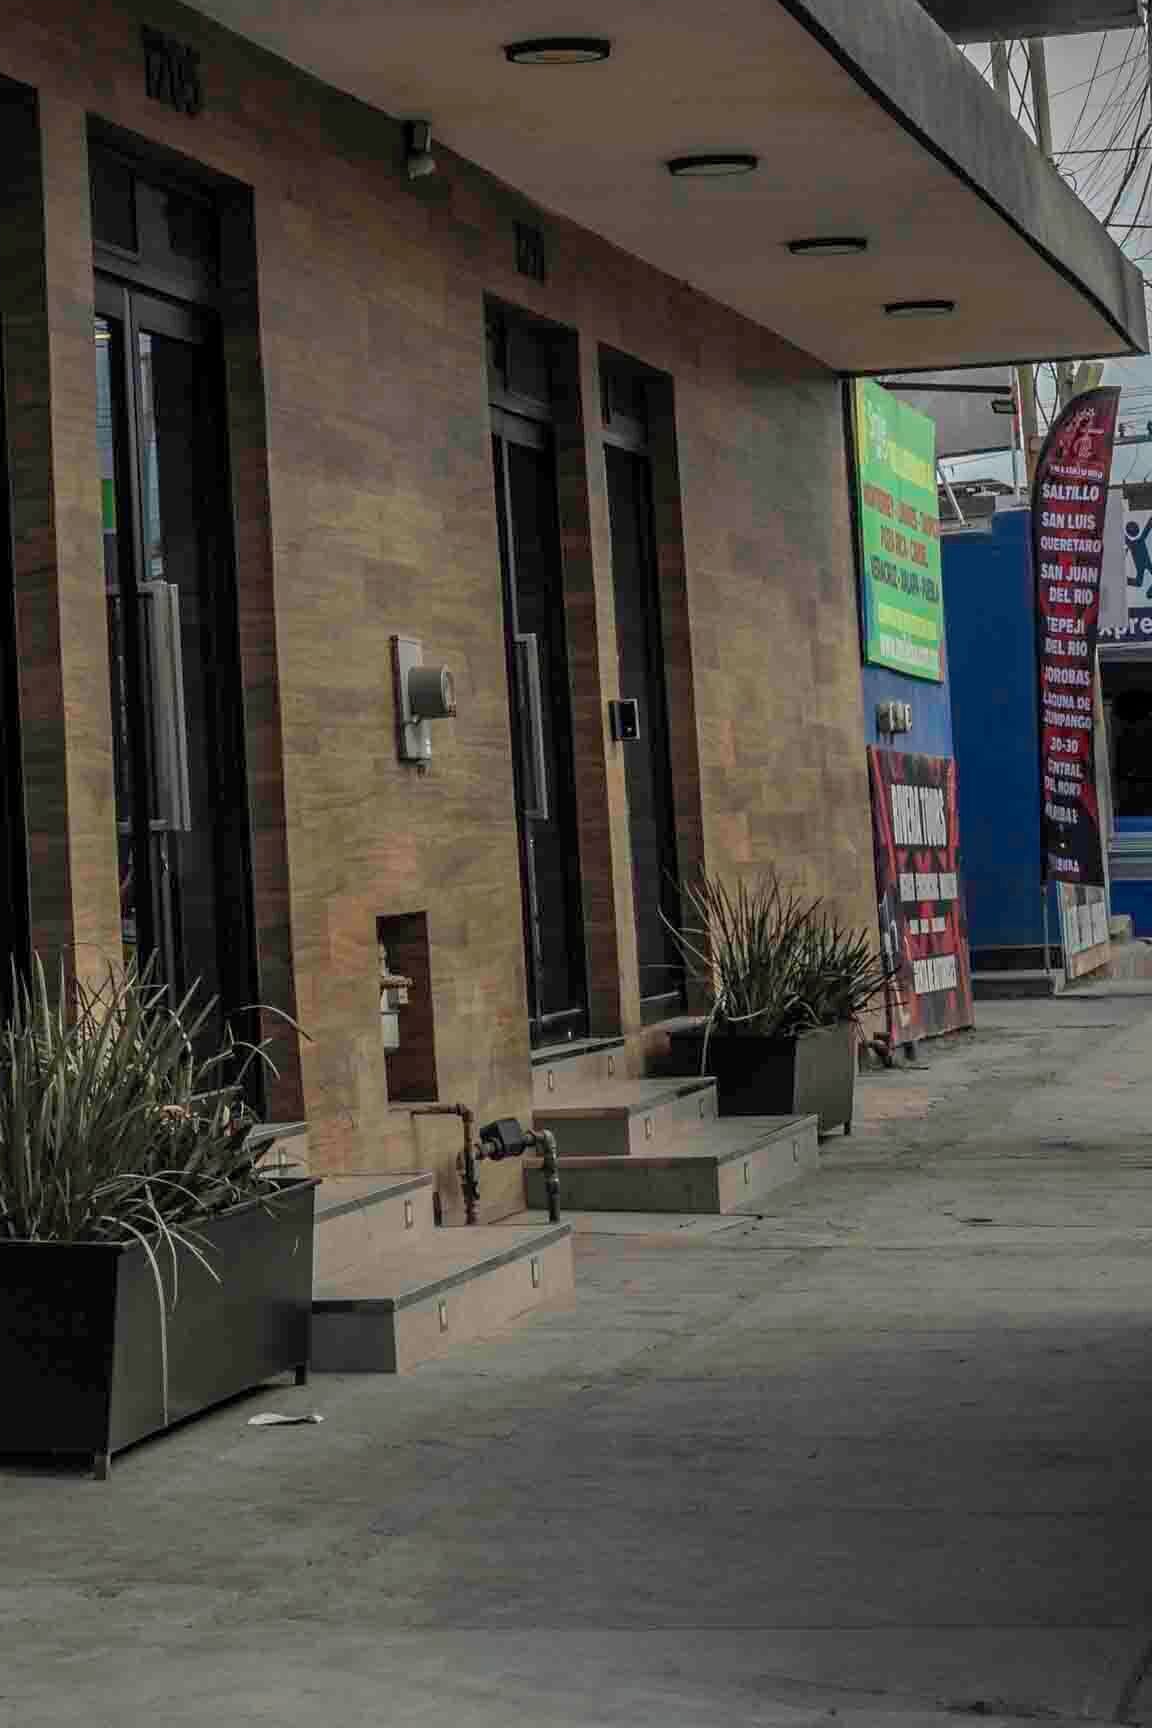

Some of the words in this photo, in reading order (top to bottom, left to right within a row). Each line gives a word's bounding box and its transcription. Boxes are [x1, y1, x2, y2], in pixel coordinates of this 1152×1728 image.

[1041, 483, 1099, 501] SALTILLO
[1041, 511, 1064, 528] SAN
[1068, 513, 1097, 530] LUIS
[1040, 535, 1102, 553] QUERETARO
[1040, 562, 1063, 579] SAN
[1065, 564, 1098, 583] JUAN
[1048, 585, 1071, 603] DEL
[1074, 588, 1094, 606] RIO
[1044, 637, 1065, 656] DEL
[1068, 638, 1088, 657] RIO
[1042, 690, 1074, 708] LAGUNA
[1076, 695, 1092, 712] DE
[1049, 736, 1079, 753] 30-30
